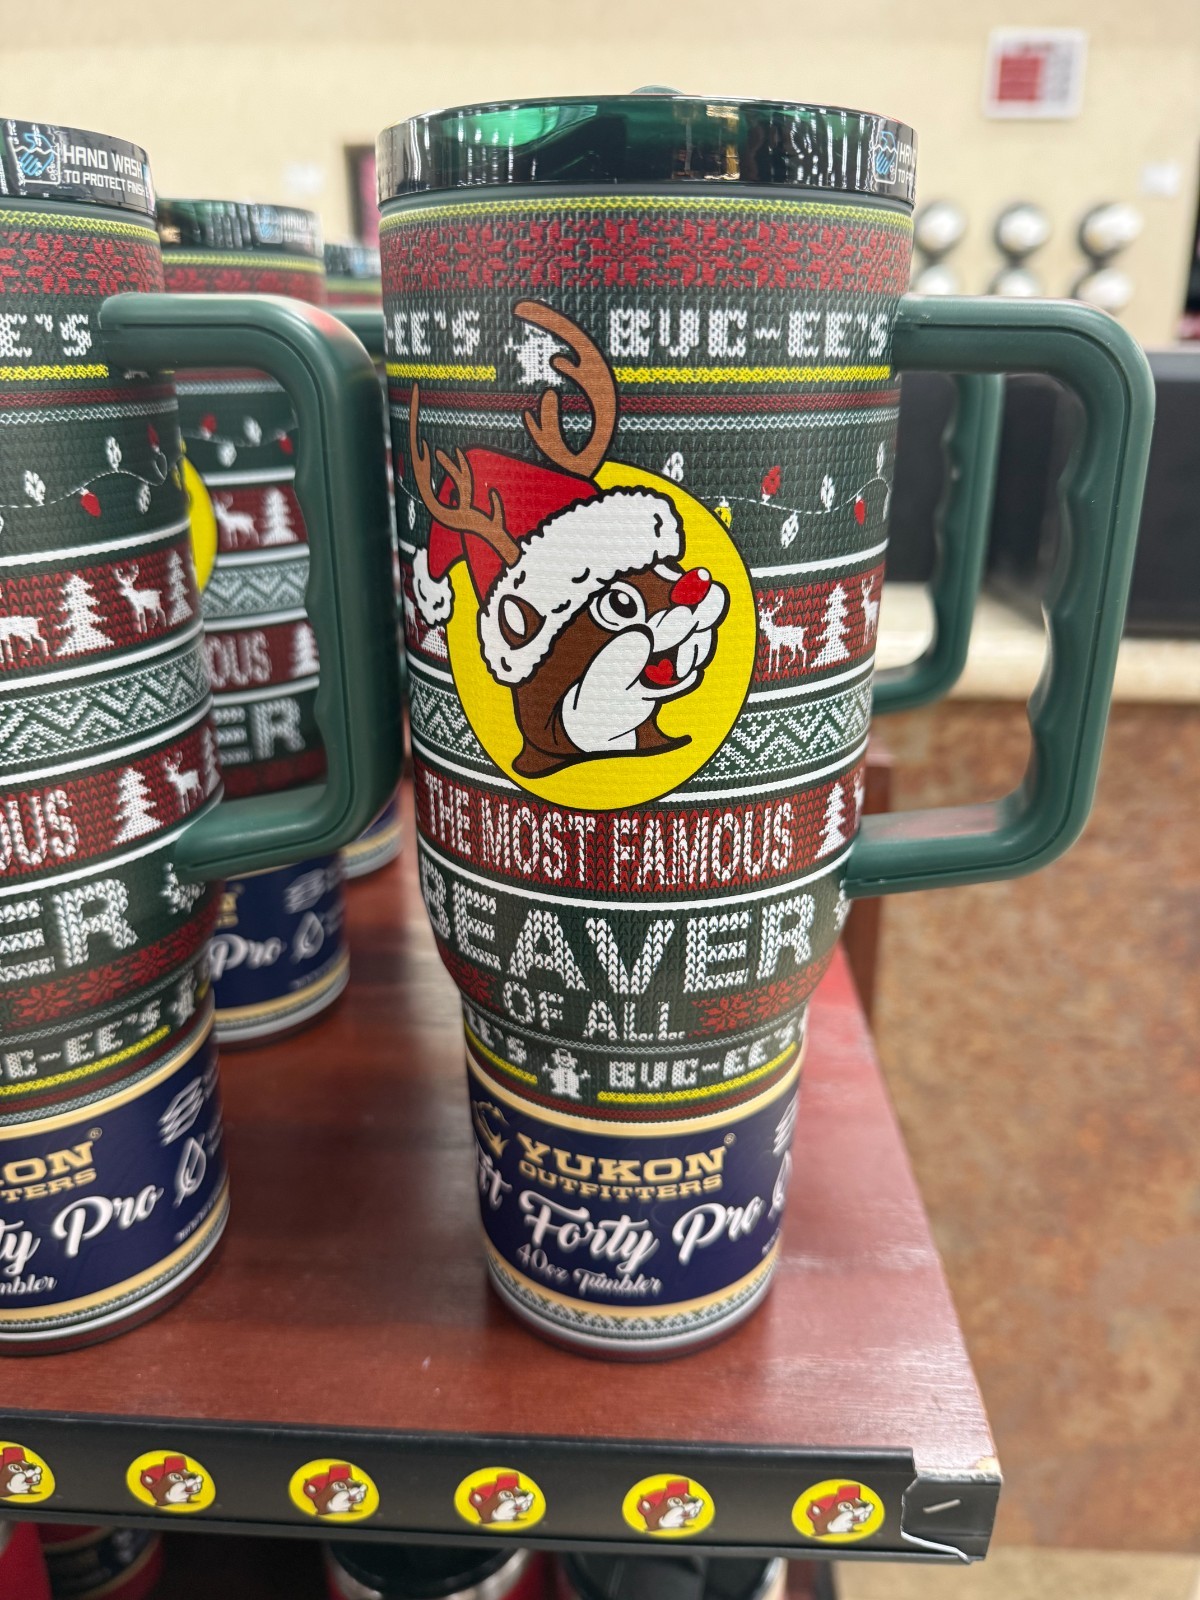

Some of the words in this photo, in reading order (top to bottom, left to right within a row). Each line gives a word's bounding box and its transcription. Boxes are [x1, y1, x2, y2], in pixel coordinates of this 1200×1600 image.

[62, 143, 109, 170] HAND
[110, 152, 143, 179] WASH
[63, 169, 81, 185] TO
[83, 172, 126, 192] PROTECT
[610, 308, 888, 358] BUC-EE'S
[424, 769, 472, 856] THE
[480, 796, 598, 884] MOST
[612, 801, 796, 886] FAMOUS
[420, 851, 816, 996] BEAVER
[502, 980, 565, 1030] OF
[583, 1000, 686, 1042] ALL
[609, 1016, 798, 1090] BUC-EE'S
[515, 1131, 728, 1184] YUKON
[518, 1159, 724, 1203] OUTFITTERS
[53, 1184, 164, 1259] Pro
[518, 1189, 661, 1276] Forty
[671, 1196, 765, 1267] Pro
[572, 1267, 664, 1296] Tumbler
